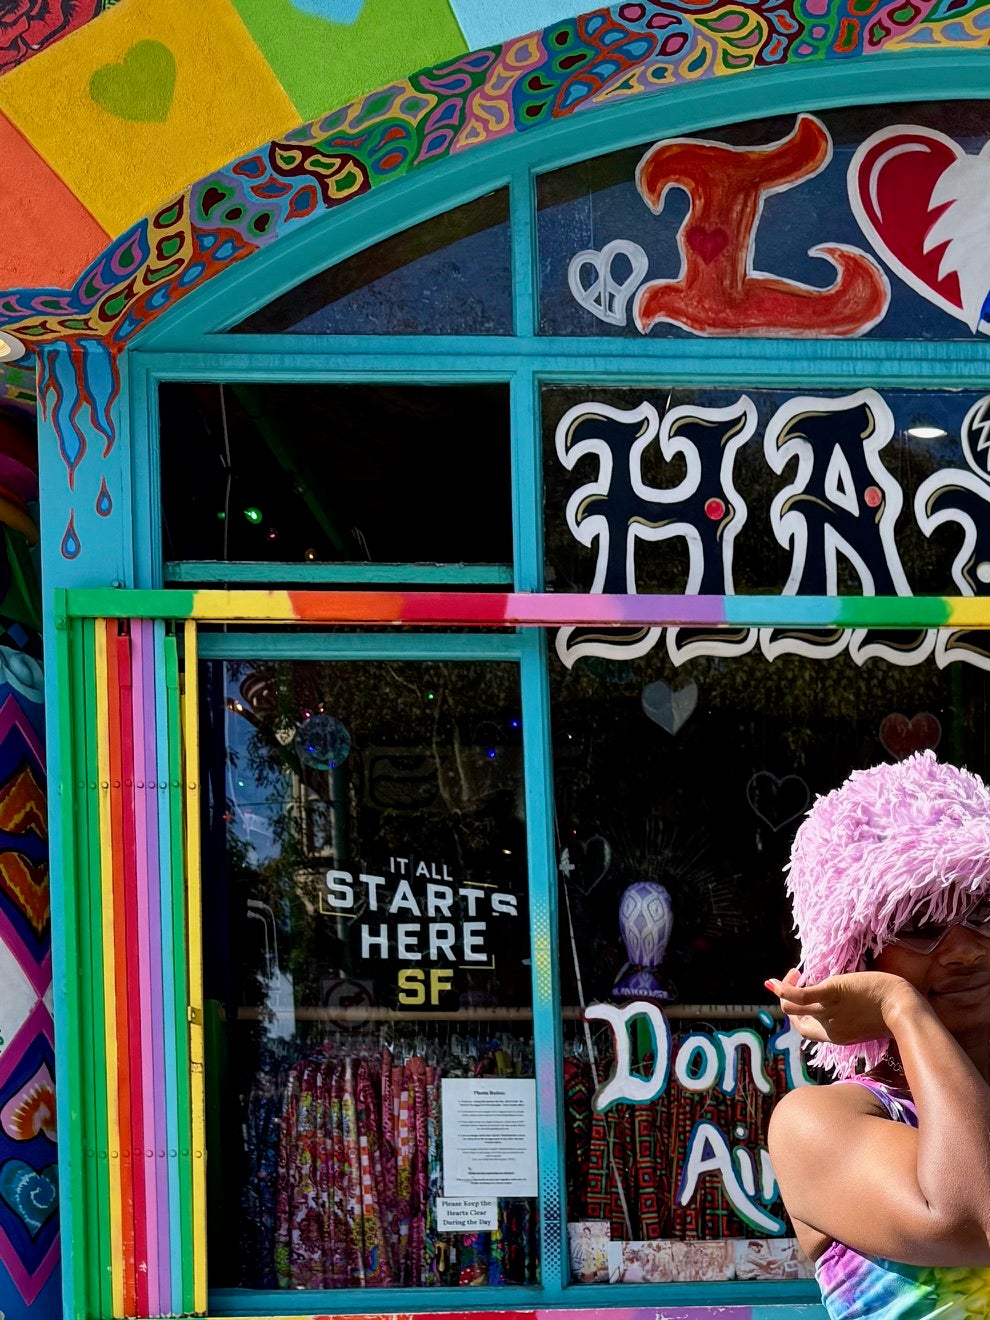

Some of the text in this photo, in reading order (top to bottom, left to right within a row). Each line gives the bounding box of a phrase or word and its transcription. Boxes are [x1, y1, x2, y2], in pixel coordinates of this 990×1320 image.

[390, 856, 453, 881] IT ALL
[326, 869, 518, 918] STARTS
[361, 921, 488, 961] HERE
[398, 969, 454, 1005] SF
[463, 1200, 480, 1208] Keep
[443, 1219, 466, 1227] During
[479, 1218, 491, 1226] Day
